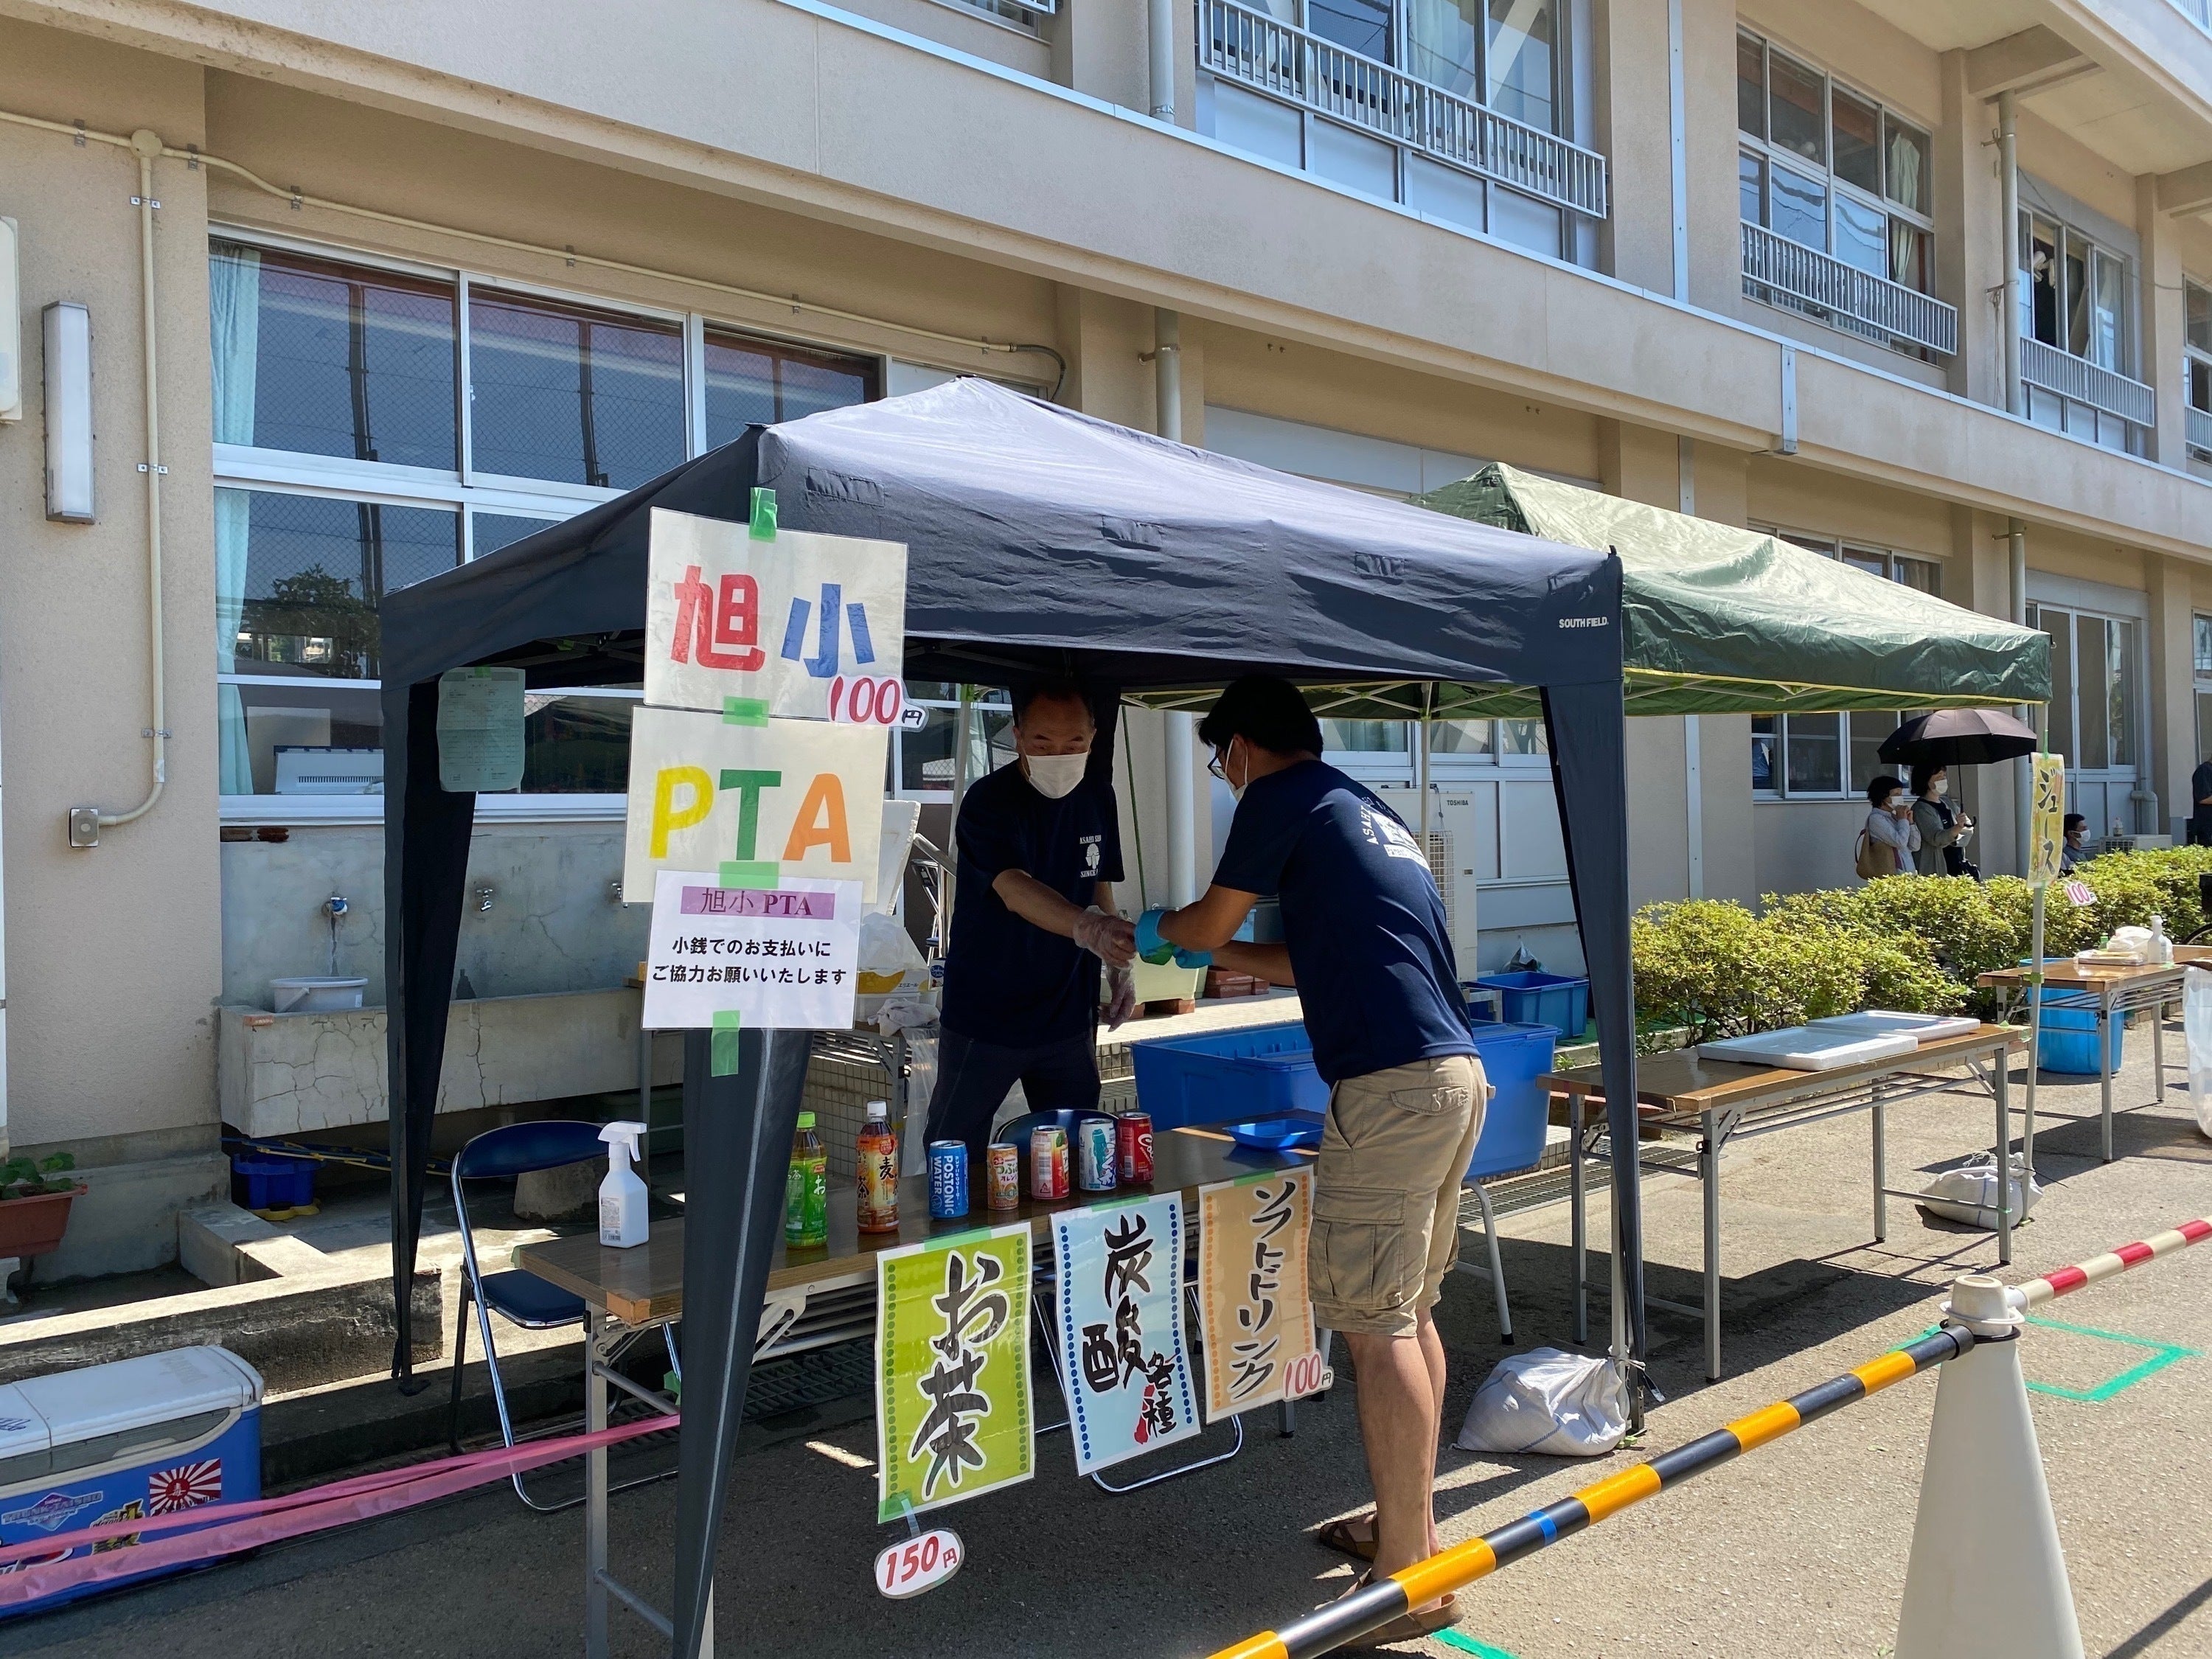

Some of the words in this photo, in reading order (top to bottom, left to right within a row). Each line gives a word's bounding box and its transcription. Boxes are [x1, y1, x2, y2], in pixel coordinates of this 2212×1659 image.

[670, 564, 875, 678] 旭小
[1559, 618, 1586, 628] SOUTH
[1586, 616, 1608, 627] FIELD
[830, 675, 923, 726] 100円
[649, 765, 852, 863] PTA
[1079, 835, 1094, 844] ASAHI
[2037, 767, 2058, 877] ジュース
[1080, 869, 1096, 878] SINCE
[700, 887, 754, 914] 旭小
[762, 894, 813, 916] PTA
[672, 936, 831, 957] 小銭でのお支払いに
[652, 964, 847, 985] ご協力お願いいたします
[933, 1155, 942, 1194] WATER
[944, 1155, 955, 1215] POSTONIC
[1082, 1214, 1154, 1394] 炭酸
[1230, 1181, 1296, 1399] ソフトドリンク
[911, 1254, 1008, 1498] お茶
[1141, 1350, 1177, 1439] 各種
[1285, 1353, 1332, 1398] 100円
[885, 1536, 958, 1590] 150円
